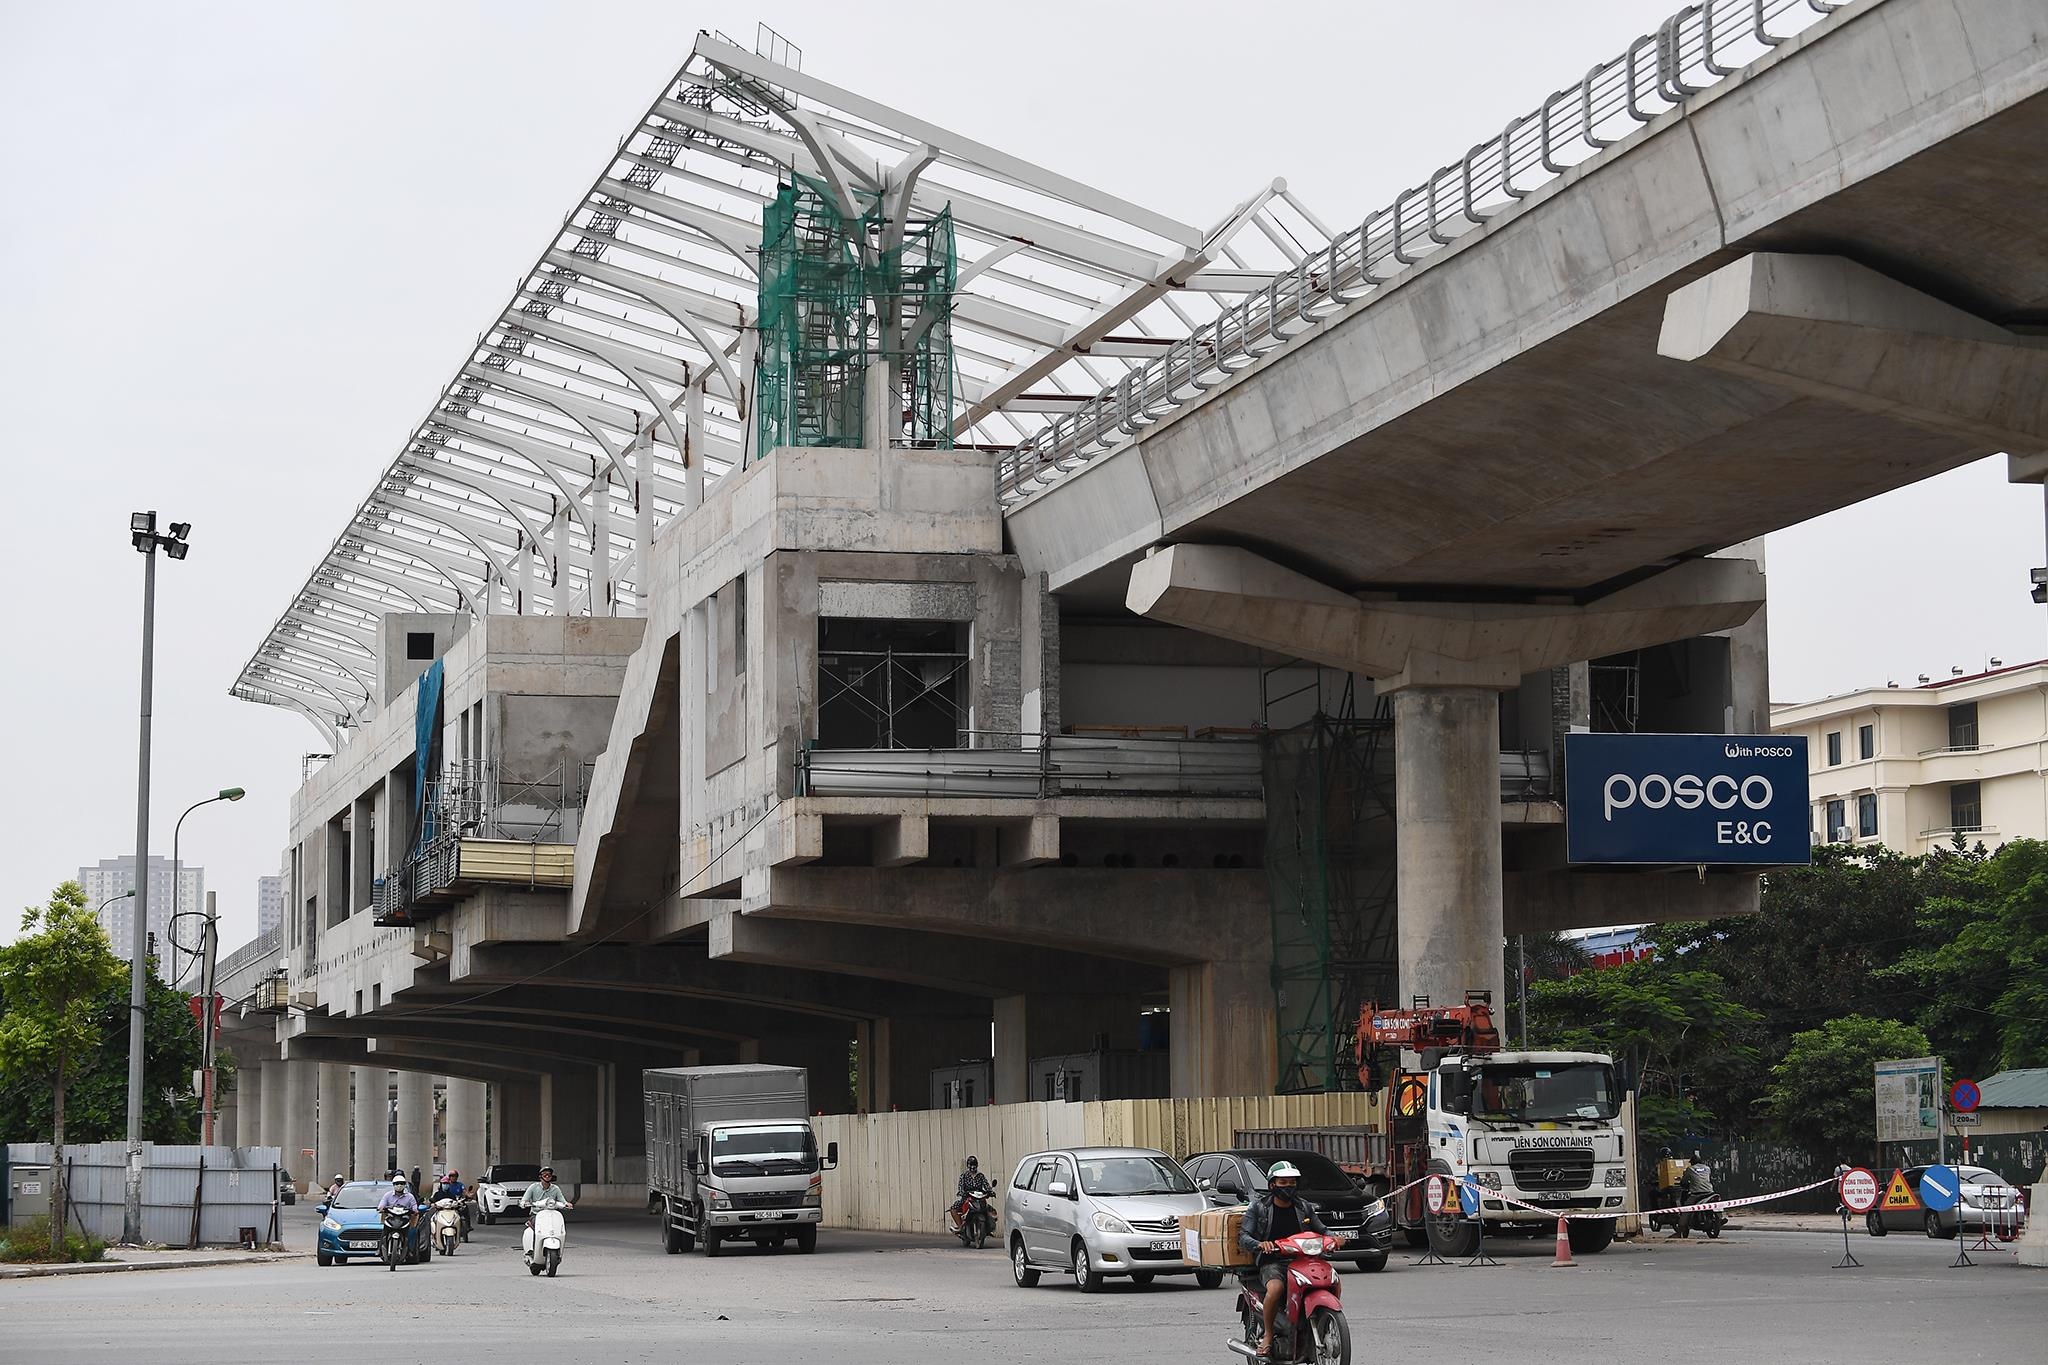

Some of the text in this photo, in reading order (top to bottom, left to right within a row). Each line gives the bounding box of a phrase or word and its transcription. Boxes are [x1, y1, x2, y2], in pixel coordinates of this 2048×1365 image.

[1754, 747, 1793, 758] POSCO
[1717, 821, 1772, 844] E&C
[1514, 1135, 1593, 1148] LIÊN SƠN CONTAINER
[1889, 1195, 1909, 1206] CHẬM
